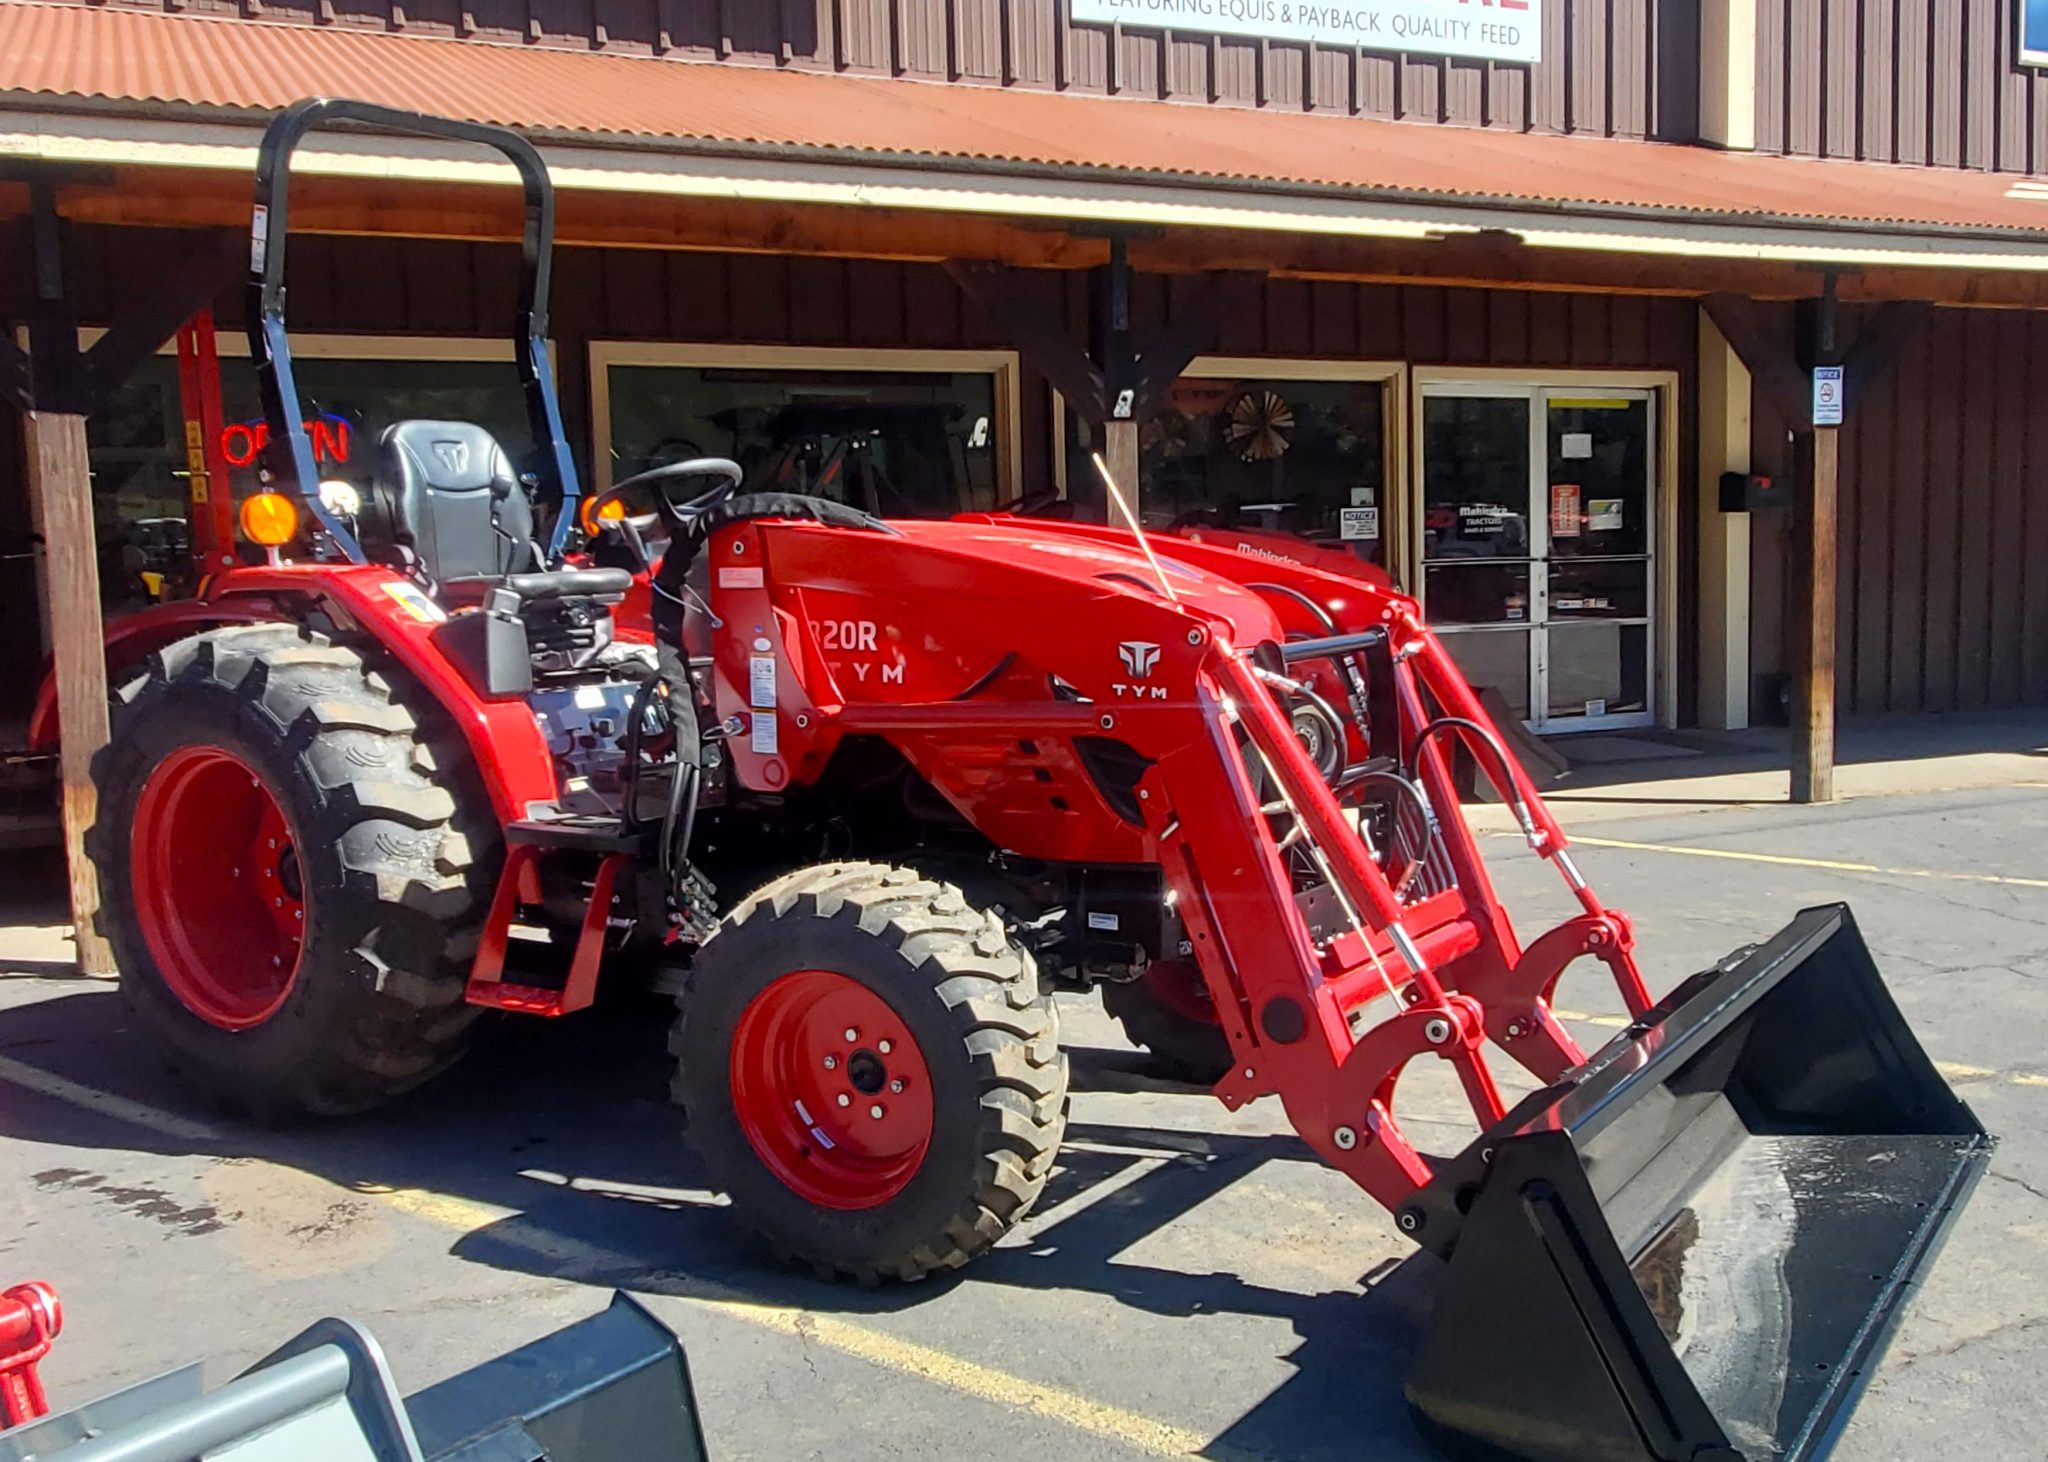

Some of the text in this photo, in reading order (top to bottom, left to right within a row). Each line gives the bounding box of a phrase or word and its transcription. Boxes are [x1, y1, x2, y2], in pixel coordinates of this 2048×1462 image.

[1098, 0, 1521, 46] URING EQUIS & PAYBACK QUALITY FEED
[221, 420, 348, 467] ON
[1344, 511, 1375, 520] NOTICE
[1112, 683, 1167, 699] TYM
